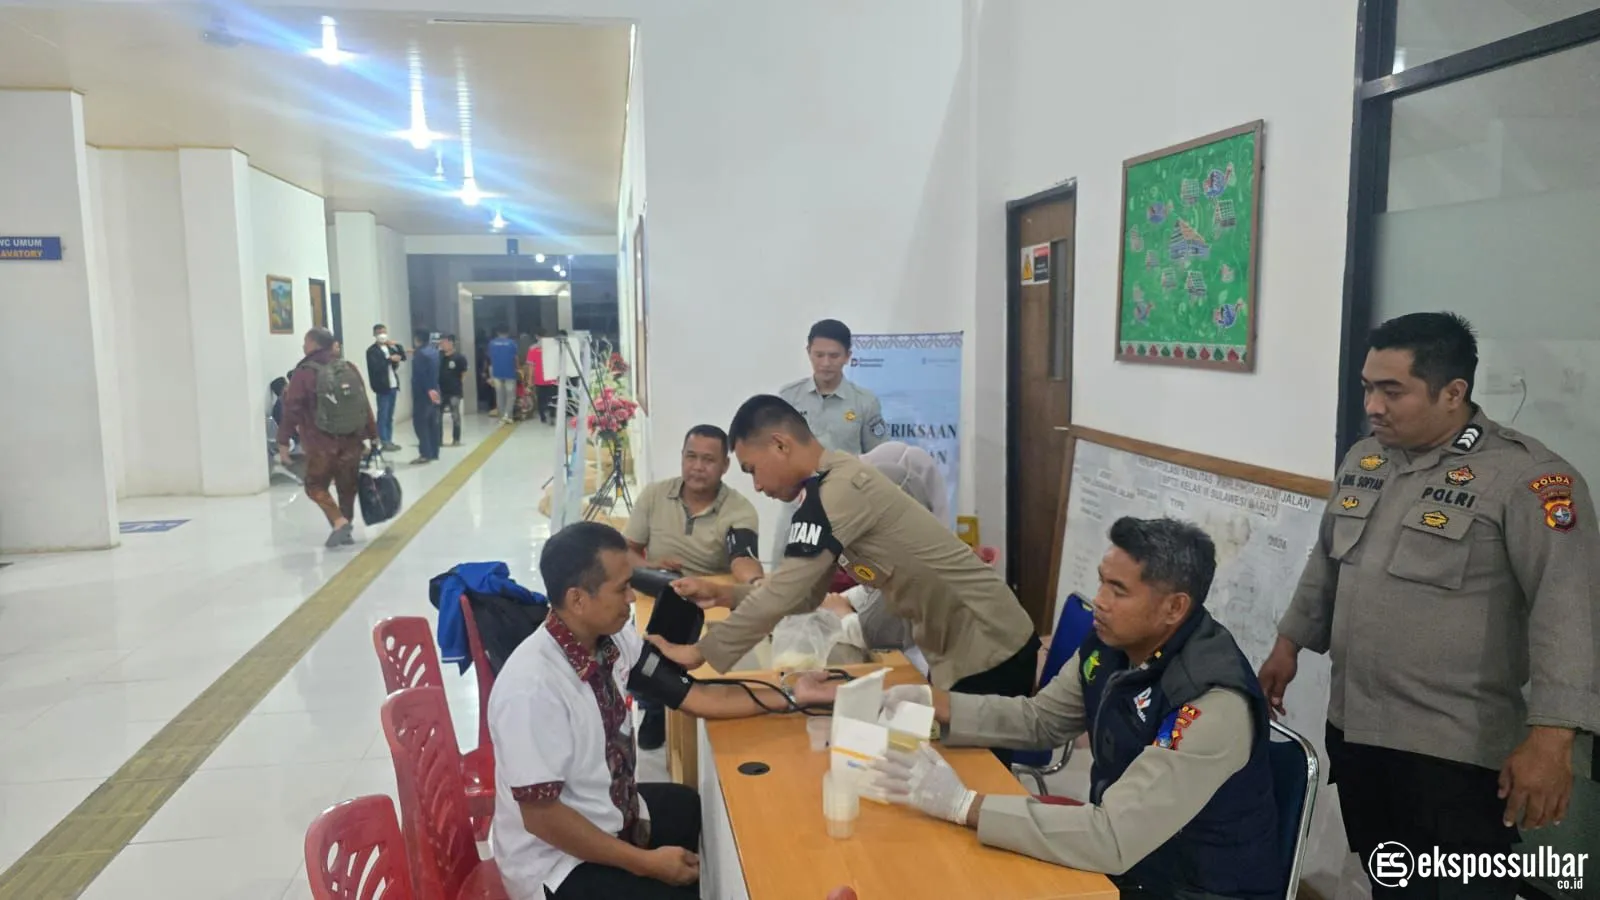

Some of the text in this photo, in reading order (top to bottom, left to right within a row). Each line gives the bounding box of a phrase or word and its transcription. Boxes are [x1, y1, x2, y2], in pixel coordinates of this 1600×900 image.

[13, 239, 42, 247] UMUM
[887, 423, 957, 439] RIKSAAN
[1532, 475, 1570, 490] POLDA
[1281, 492, 1312, 510] JALAN
[1421, 487, 1476, 508] POLRI
